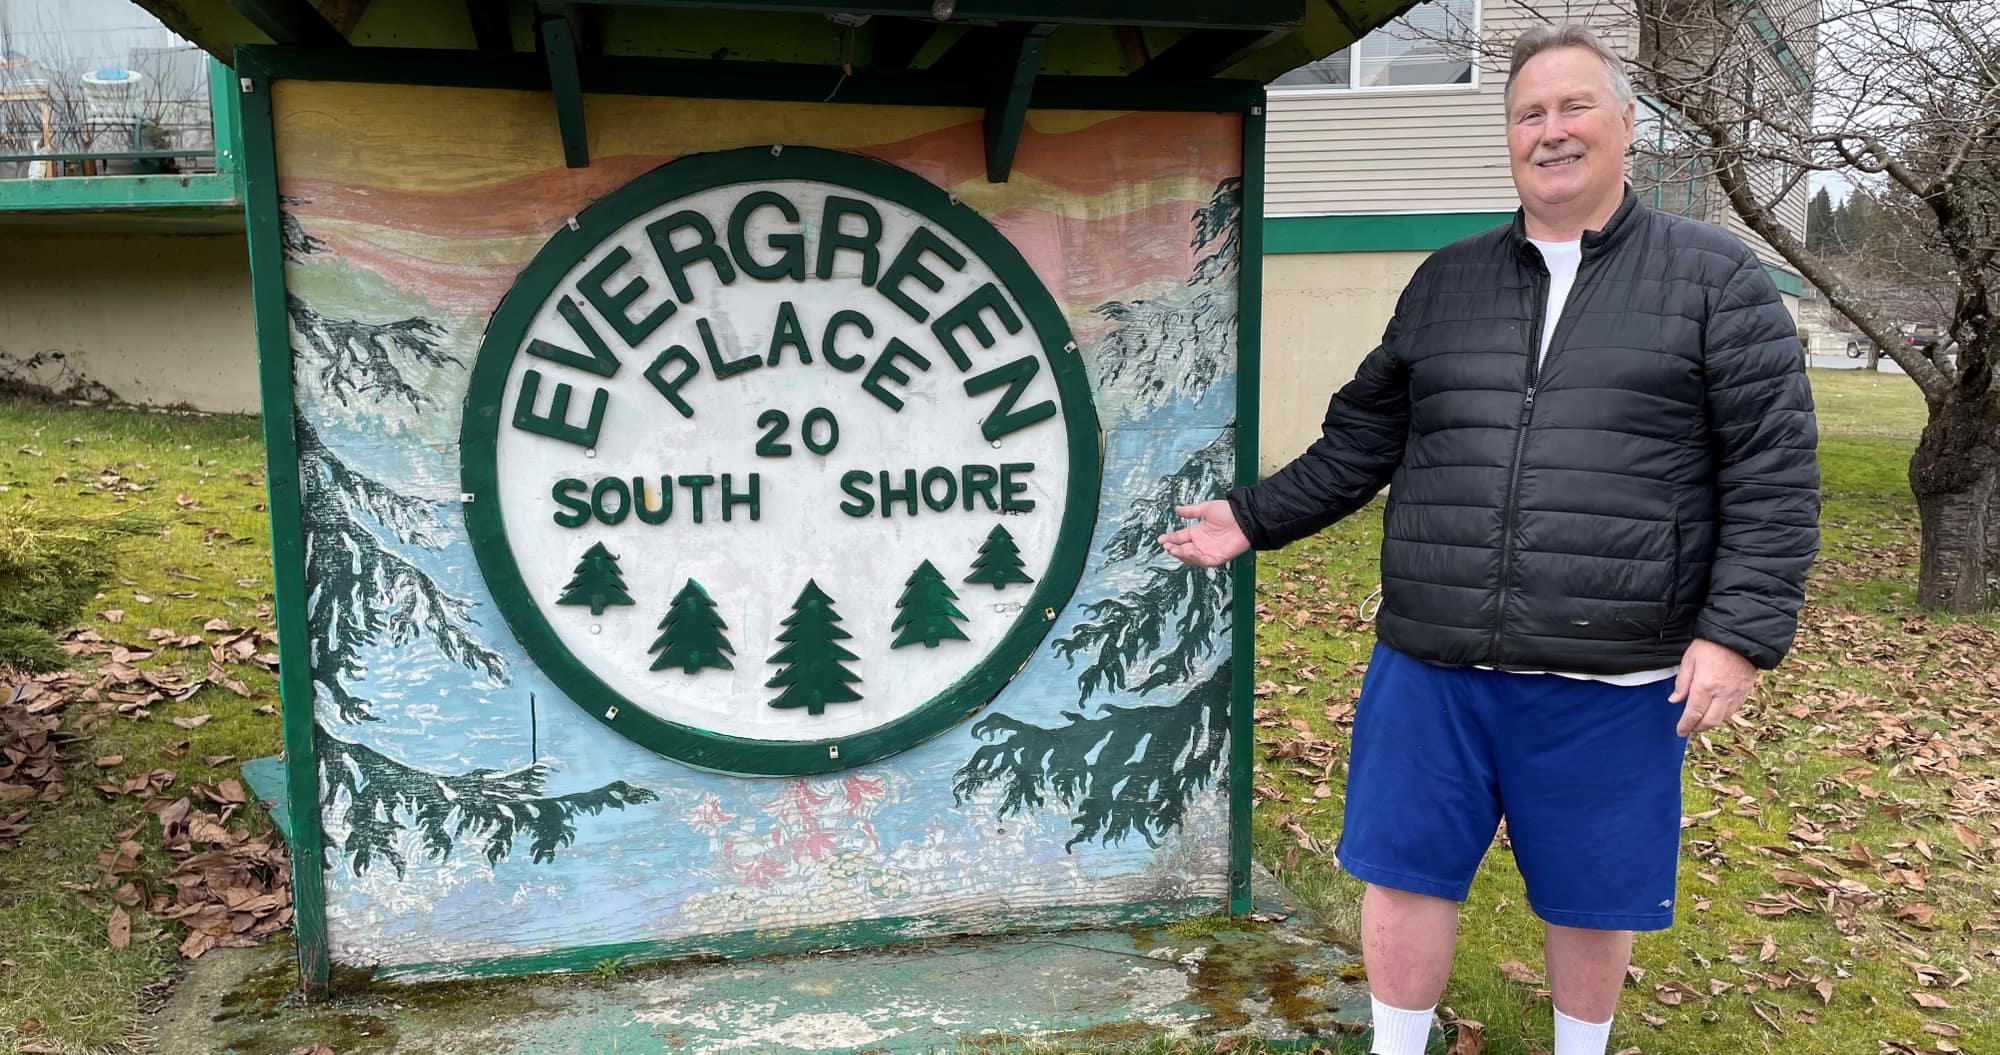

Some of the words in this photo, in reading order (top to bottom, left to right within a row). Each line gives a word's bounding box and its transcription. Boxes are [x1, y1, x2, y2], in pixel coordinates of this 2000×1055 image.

[512, 191, 1057, 449] EVERGREEN
[643, 301, 931, 418] PLACE
[755, 407, 840, 457] 20
[552, 472, 760, 528] SOUTH
[840, 462, 1036, 518] SHORE
